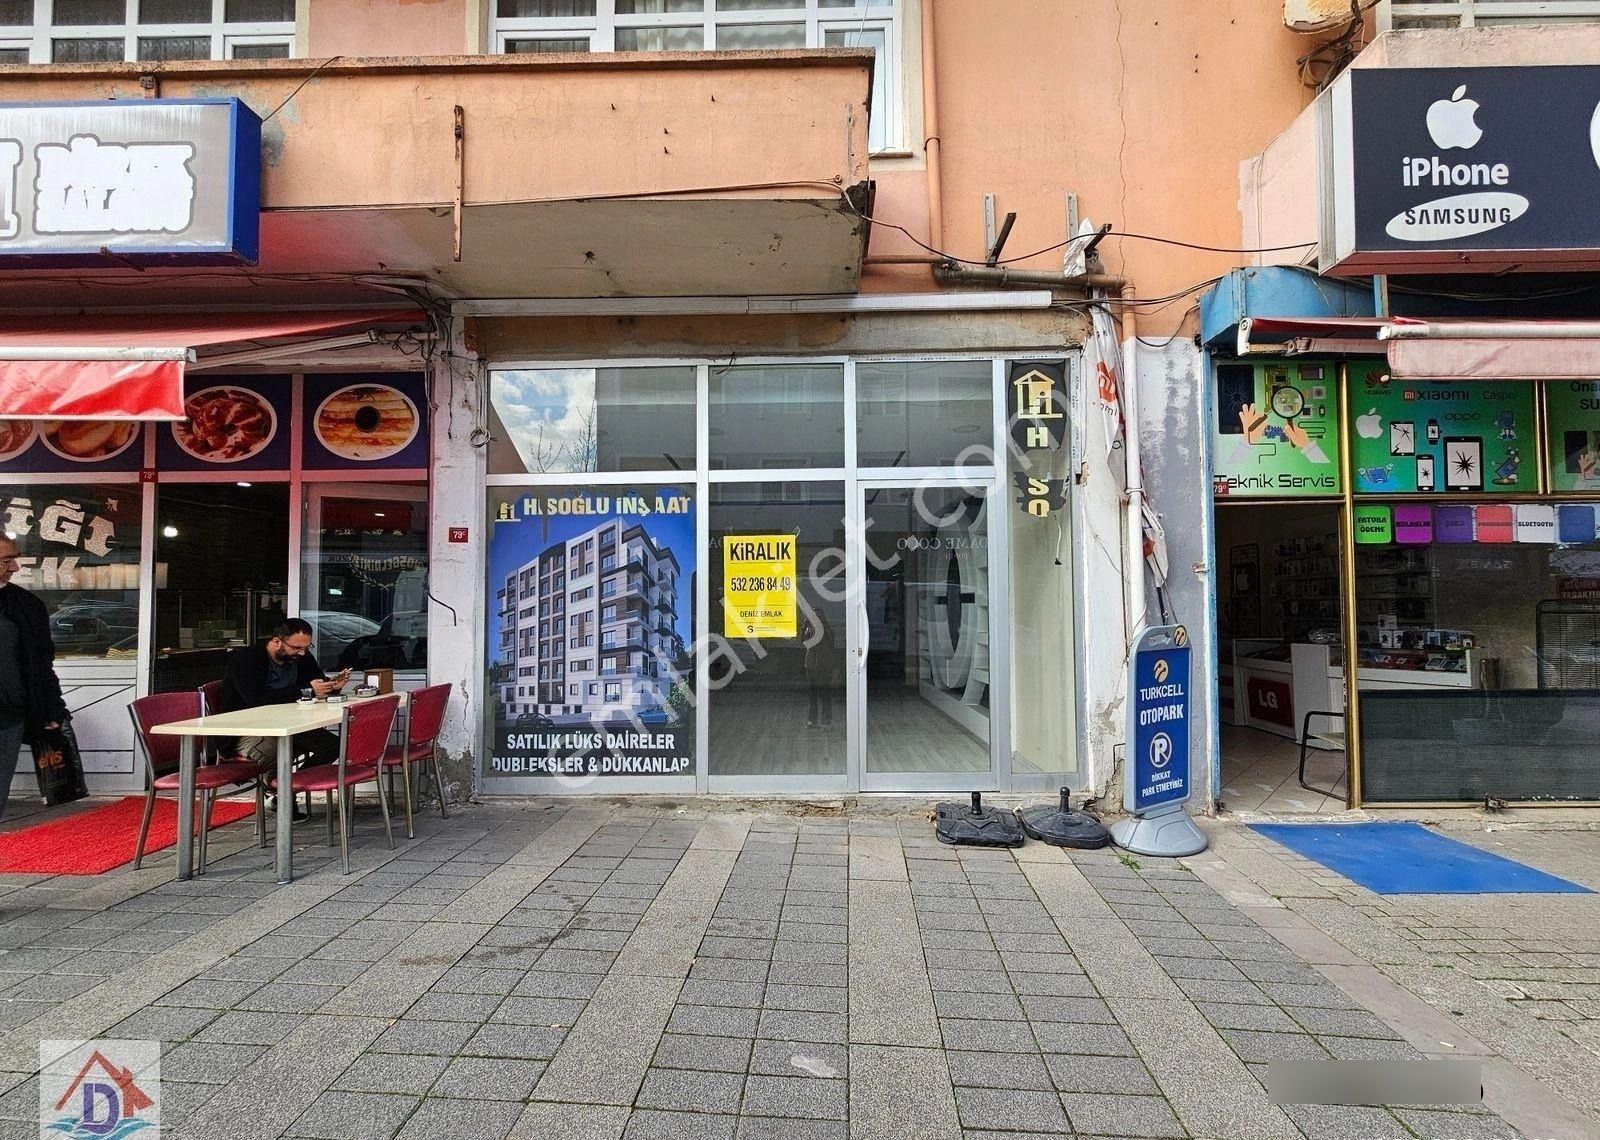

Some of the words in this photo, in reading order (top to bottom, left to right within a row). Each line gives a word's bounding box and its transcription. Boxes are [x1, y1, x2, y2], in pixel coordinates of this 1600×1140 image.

[1402, 156, 1509, 186] iPhone
[1404, 207, 1511, 225] SAMSUNG
[1278, 473, 1335, 488] Servis
[731, 577, 747, 591] 532
[749, 577, 765, 591] 236
[767, 577, 777, 590] 84
[780, 576, 791, 590] 49
[1140, 684, 1184, 702] TURKCELL
[1258, 689, 1279, 709] LG
[1140, 704, 1184, 726] OTOPARK
[507, 734, 562, 750] SATILIK
[565, 731, 602, 749] LÜKS
[1142, 785, 1155, 798] PARK
